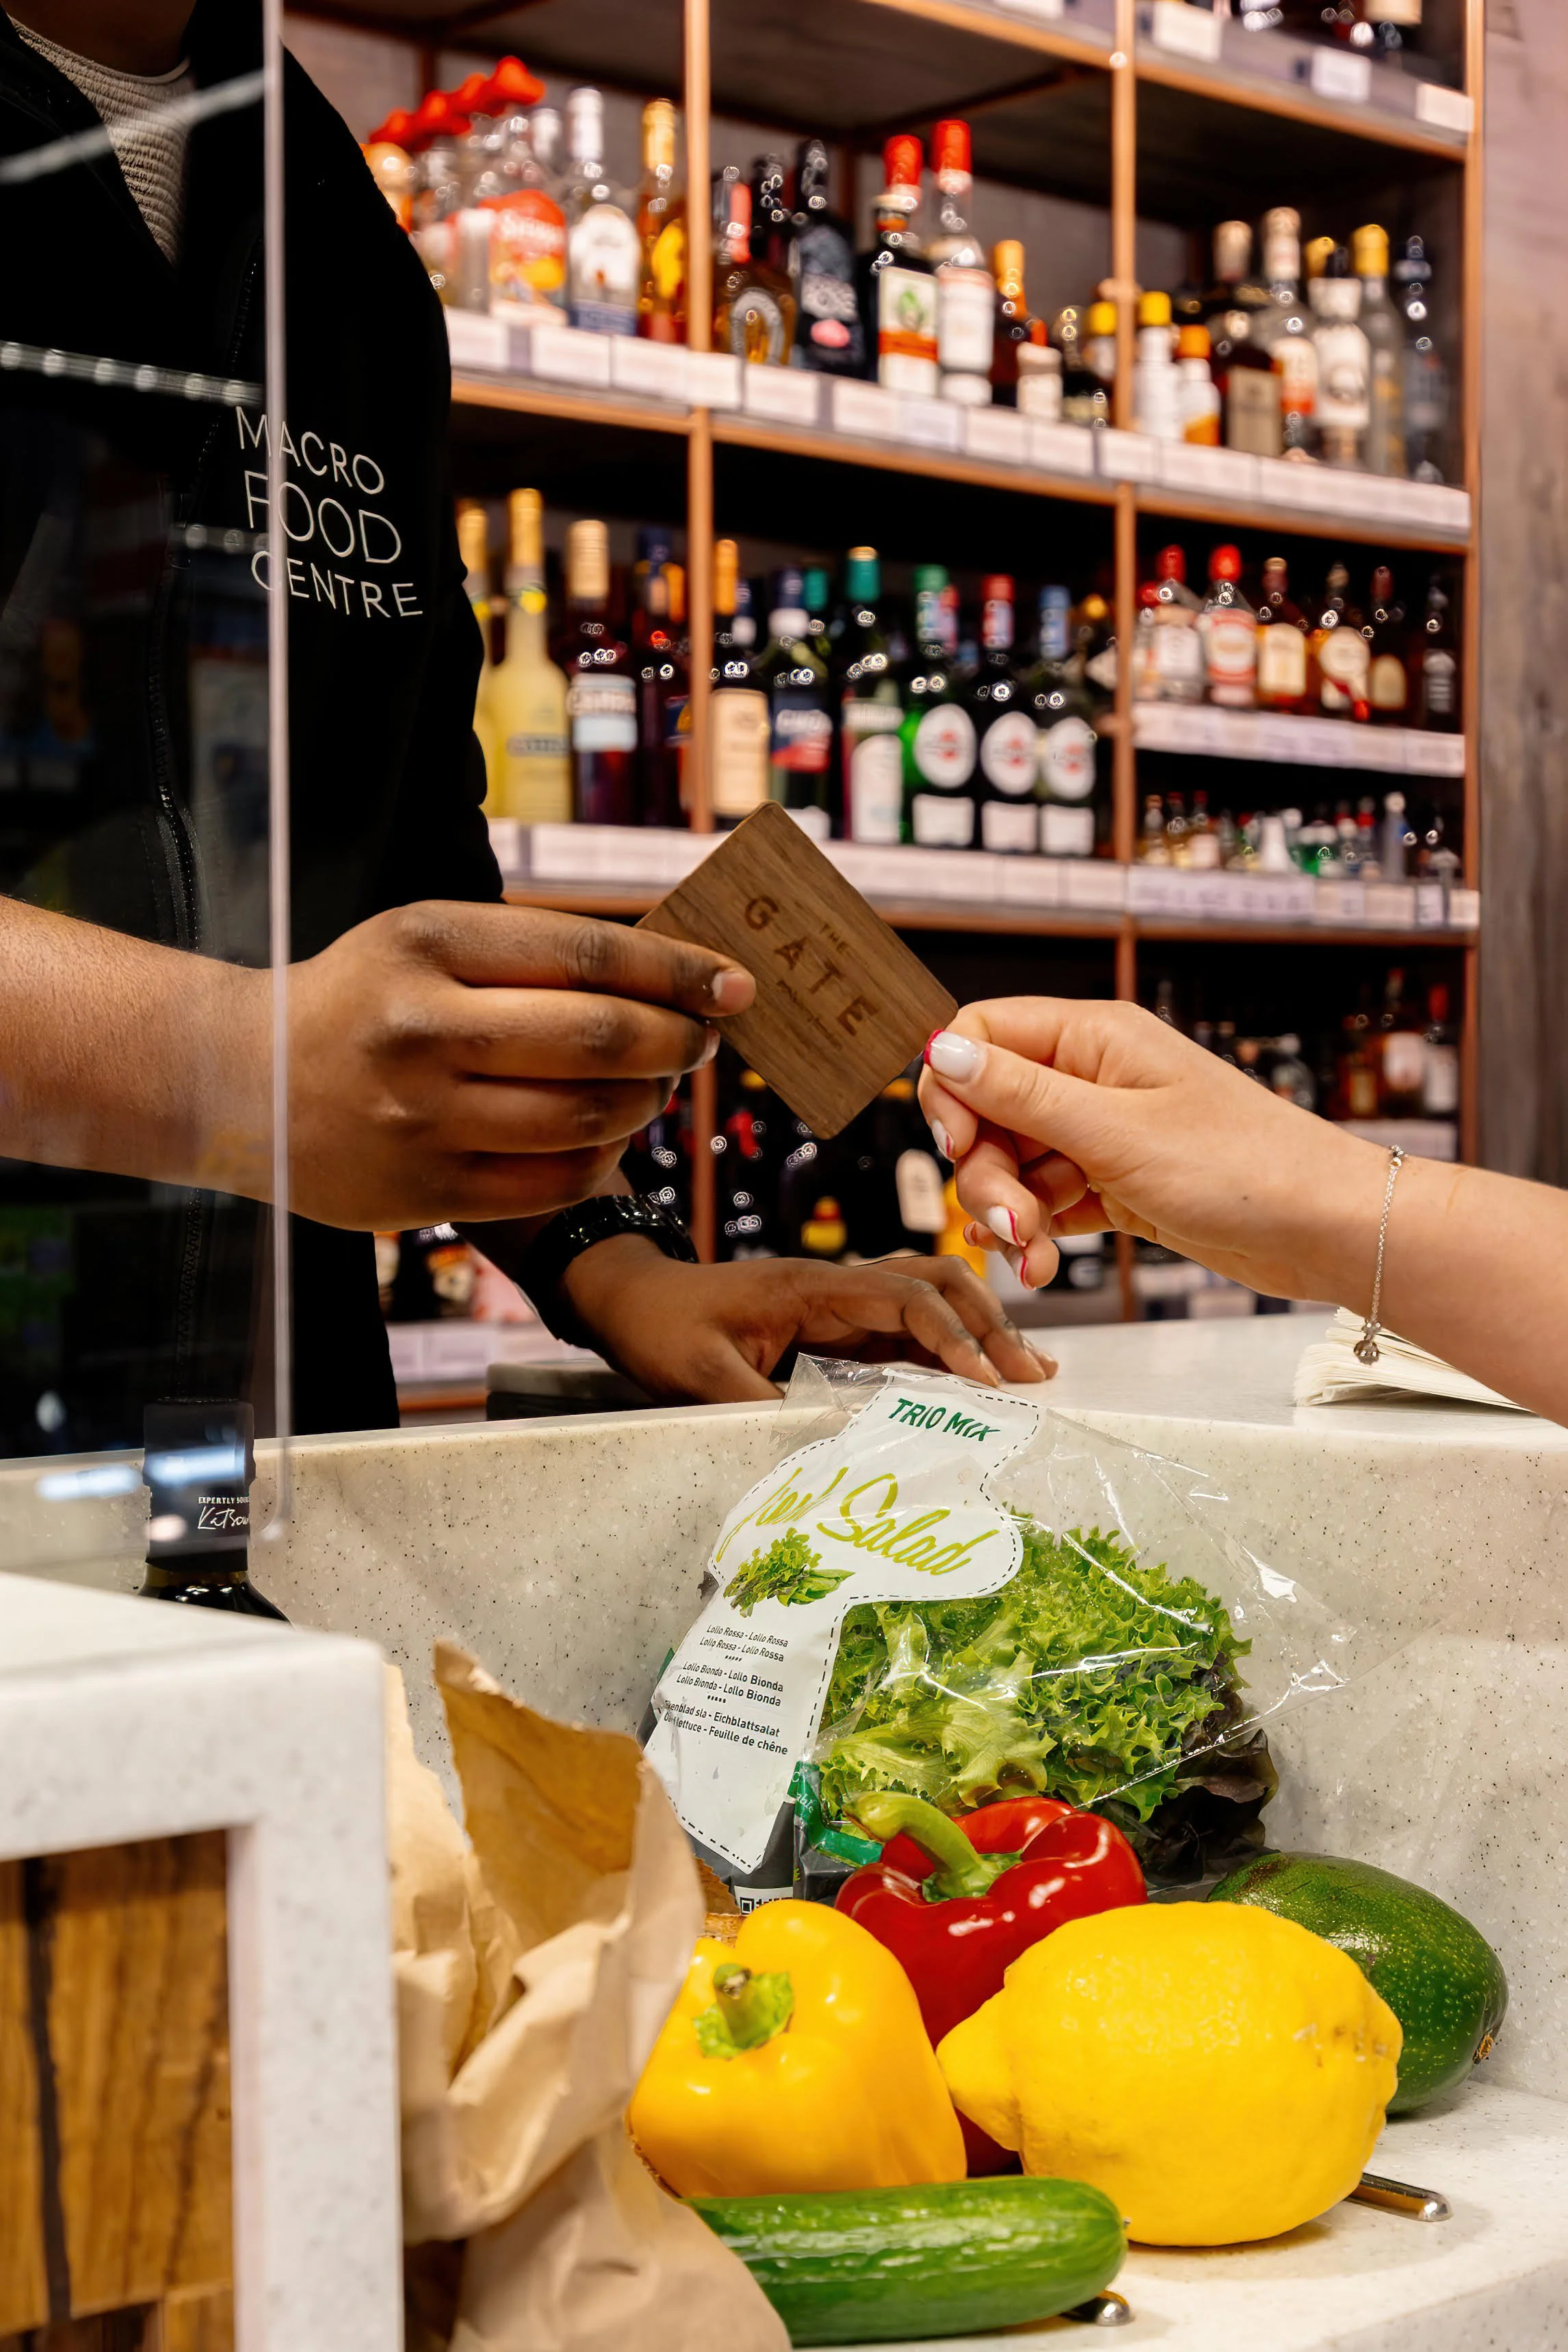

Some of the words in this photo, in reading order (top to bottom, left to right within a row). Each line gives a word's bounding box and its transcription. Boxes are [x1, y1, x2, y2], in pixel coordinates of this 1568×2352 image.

[236, 406, 384, 495] MACRO
[244, 470, 402, 564] FOOD
[251, 550, 423, 618] CENTRE
[744, 893, 879, 1037] GATE
[888, 1398, 947, 1429] TRIO
[942, 1411, 1001, 1441] MIX
[816, 1472, 999, 1576] Salad
[700, 1636, 716, 1647] Lollo
[716, 1639, 737, 1651] Rossa
[742, 1644, 759, 1655] Lollo
[759, 1647, 784, 1662] Rossa
[707, 1624, 723, 1634] Lollo
[724, 1627, 744, 1638] Rossa
[748, 1632, 767, 1642] Lollo
[766, 1635, 788, 1647] Rossa
[676, 1674, 693, 1685] Lollo
[694, 1677, 718, 1690] Bionda
[723, 1684, 744, 1697] Lollo
[746, 1689, 781, 1706] Bionda
[683, 1661, 700, 1671] Lollo
[700, 1664, 723, 1676] Bionda
[729, 1670, 748, 1682] Lollo
[750, 1675, 784, 1692] Bionda
[695, 1708, 707, 1719] sla
[714, 1712, 781, 1738] Eichblattsalat
[708, 1725, 740, 1742] Feuille
[742, 1735, 755, 1746] de
[757, 1740, 788, 1755] chêne
